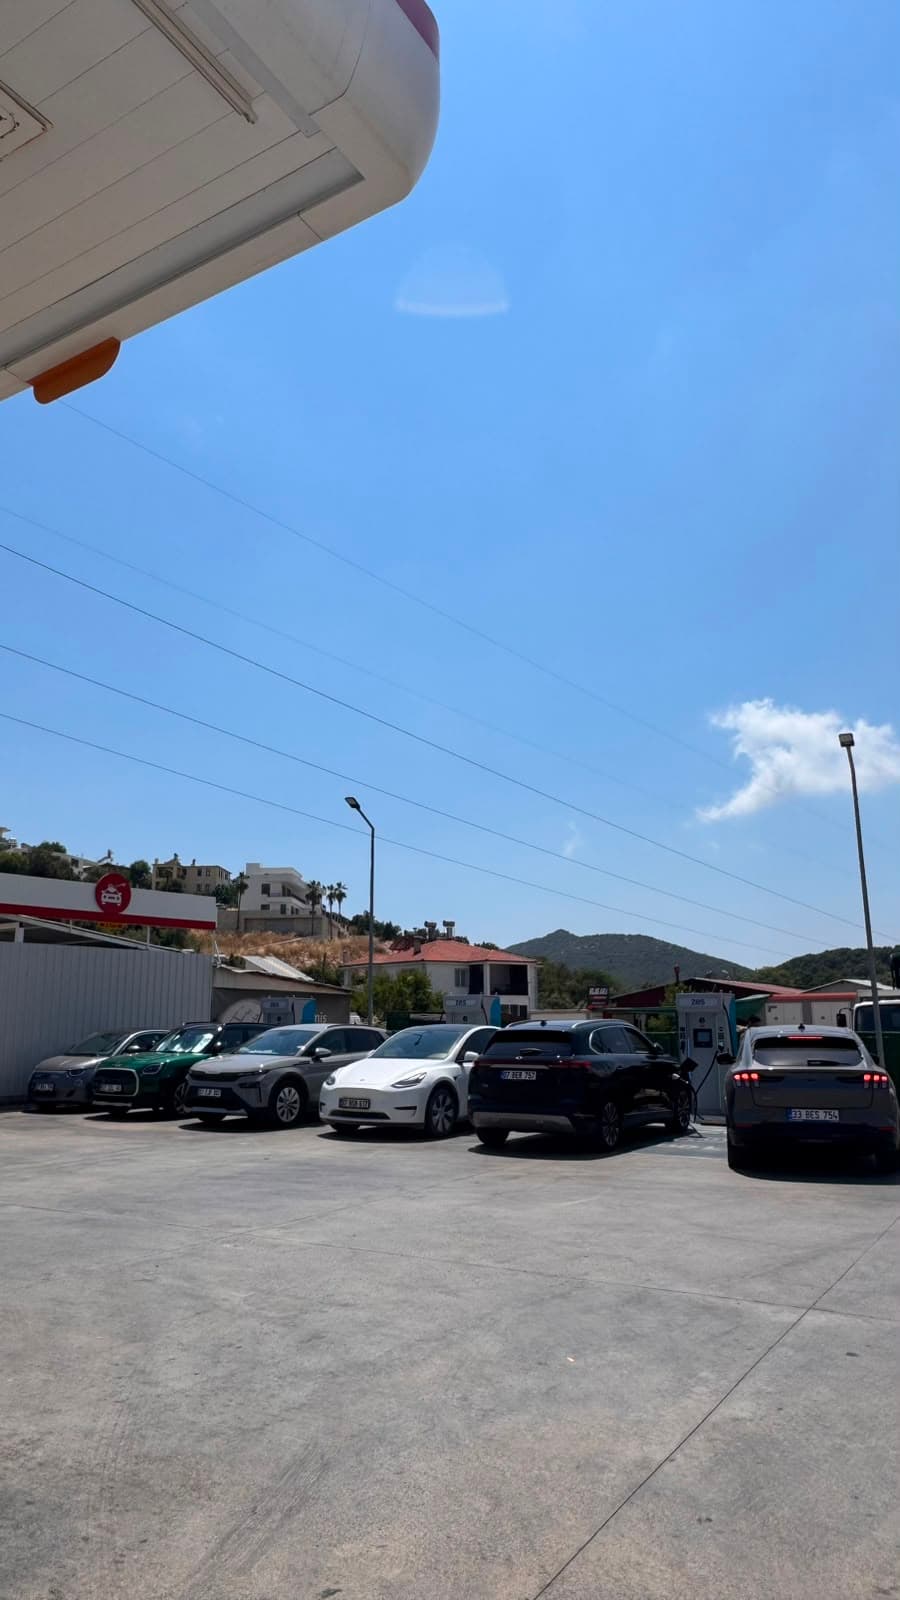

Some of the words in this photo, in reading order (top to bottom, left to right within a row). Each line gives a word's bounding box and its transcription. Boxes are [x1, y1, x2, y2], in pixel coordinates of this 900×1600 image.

[792, 1110, 801, 1120] 33
[806, 1110, 819, 1120] BES
[824, 1110, 839, 1120] 754
